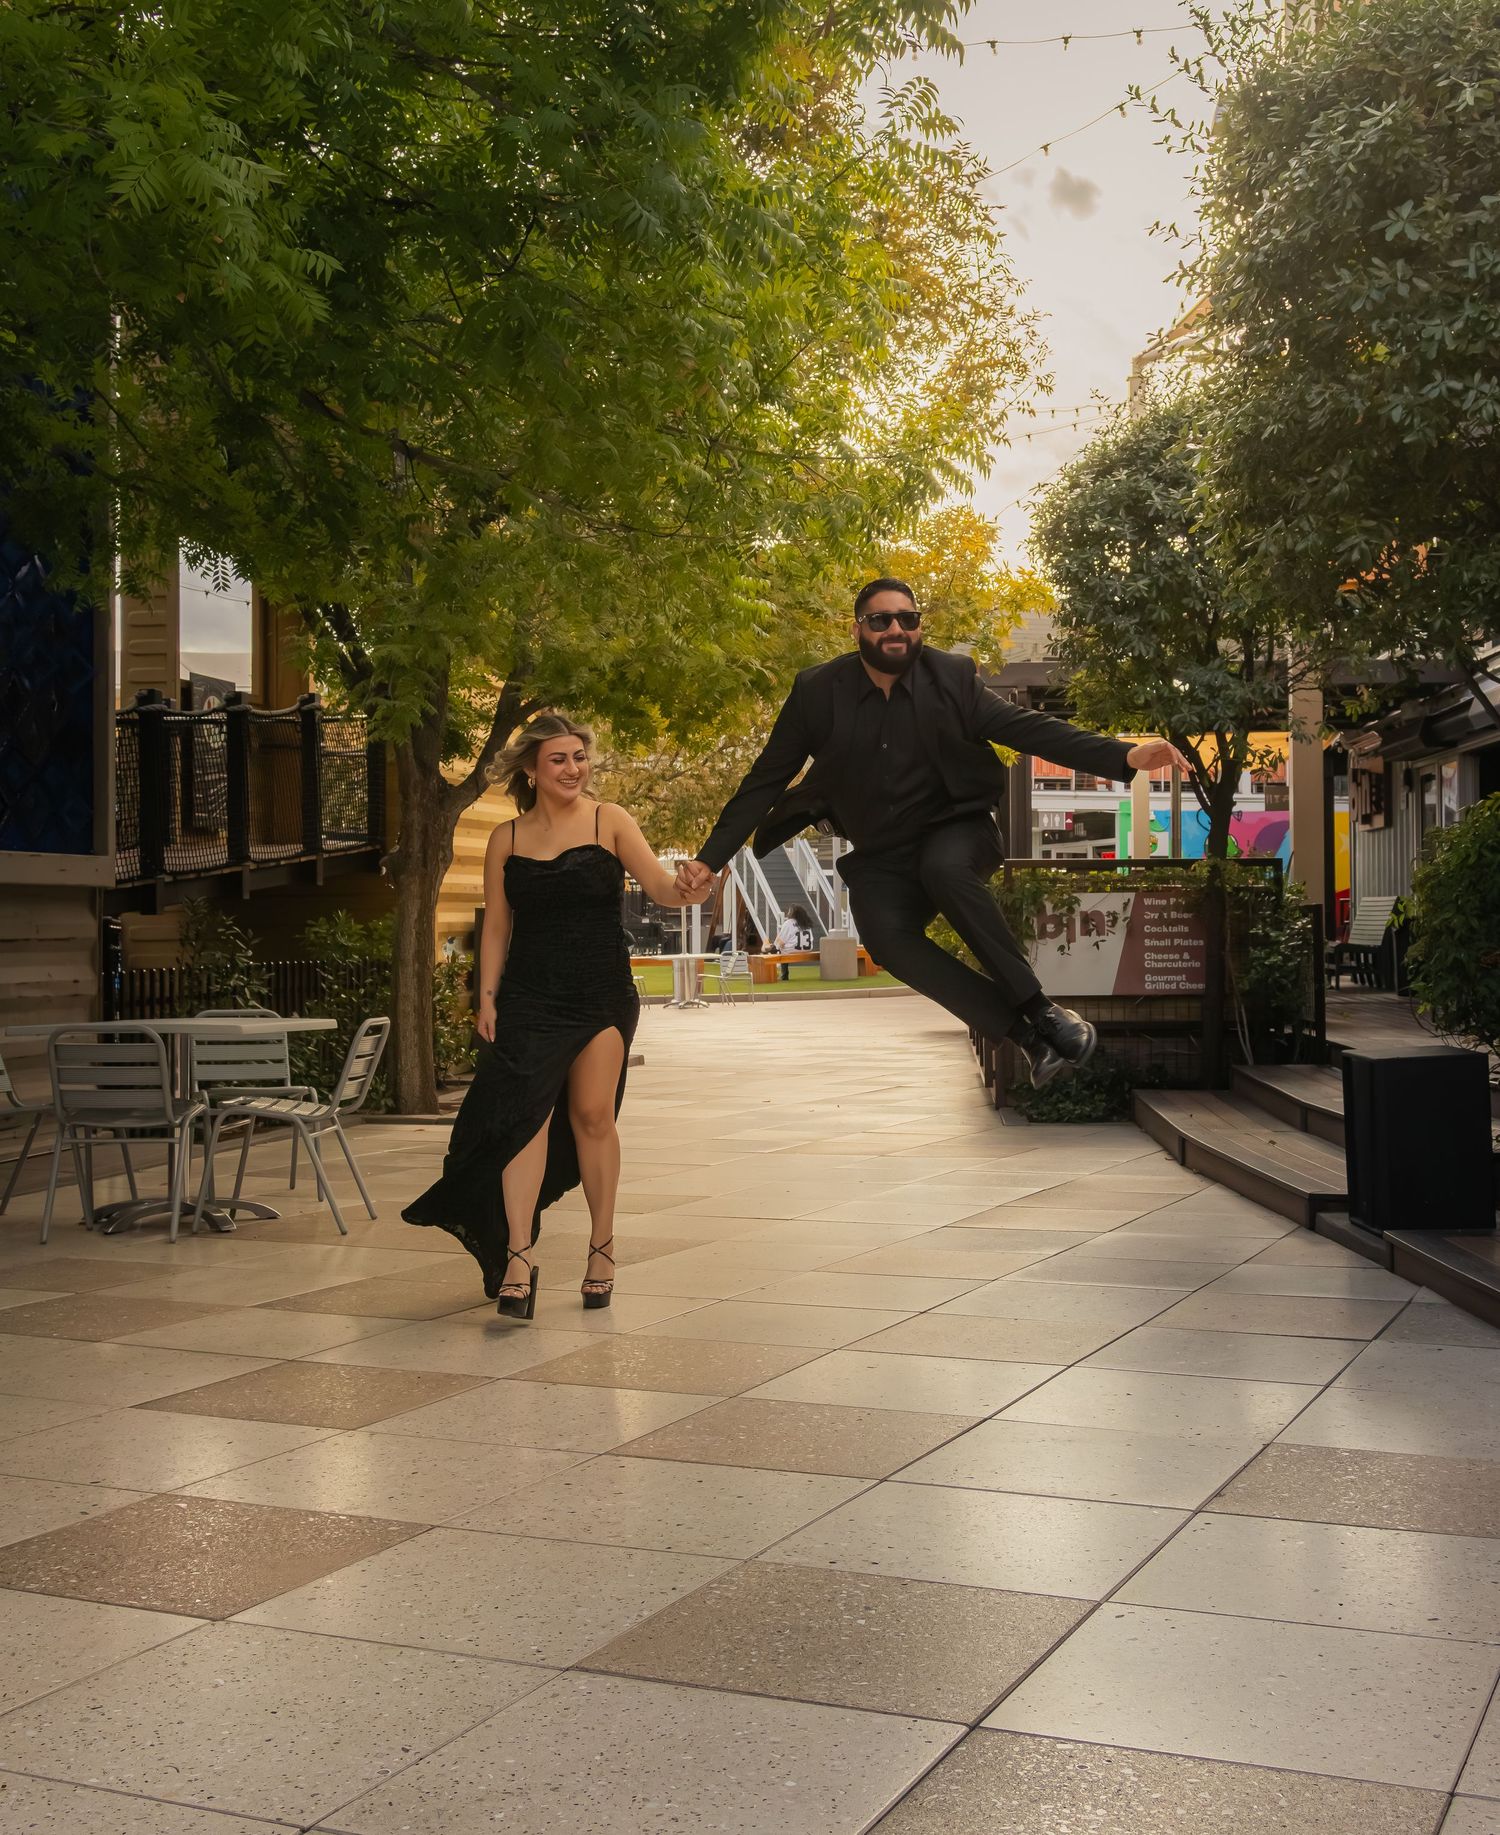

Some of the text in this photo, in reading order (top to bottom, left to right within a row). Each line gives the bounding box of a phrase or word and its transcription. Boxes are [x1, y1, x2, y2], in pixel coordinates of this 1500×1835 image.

[1144, 897, 1167, 905] Wine
[1170, 911, 1192, 919] Beer
[1144, 925, 1189, 933] Cocktails
[794, 931, 812, 951] 13
[1144, 938, 1204, 946] Small Plates
[1144, 952, 1190, 960] Cheese &
[1144, 960, 1201, 968] Charcuterie
[1145, 974, 1187, 982] Gourmet
[1145, 982, 1205, 990] Grilled Chee
